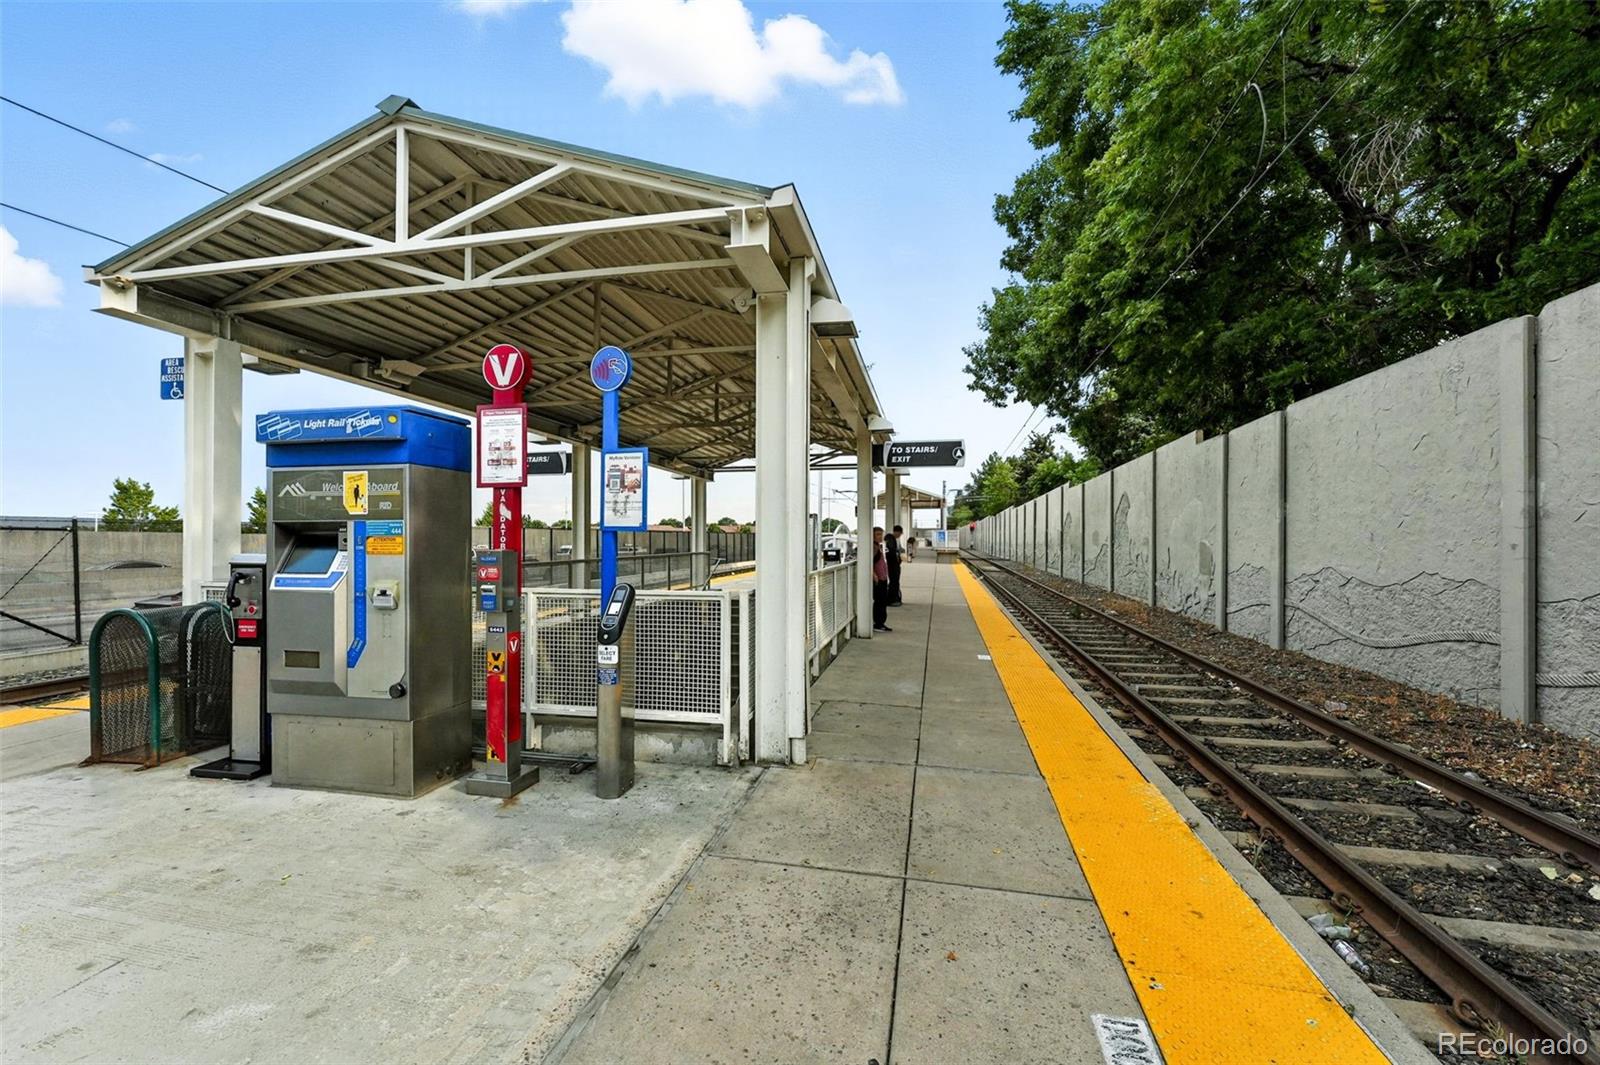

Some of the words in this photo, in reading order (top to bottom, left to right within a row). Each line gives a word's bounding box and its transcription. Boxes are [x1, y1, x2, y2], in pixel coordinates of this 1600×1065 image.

[488, 353, 519, 386] V
[303, 419, 327, 430] Light
[328, 418, 345, 428] Rail
[891, 446, 903, 454] TO
[905, 445, 938, 454] STAIRS/
[510, 640, 519, 652] V
